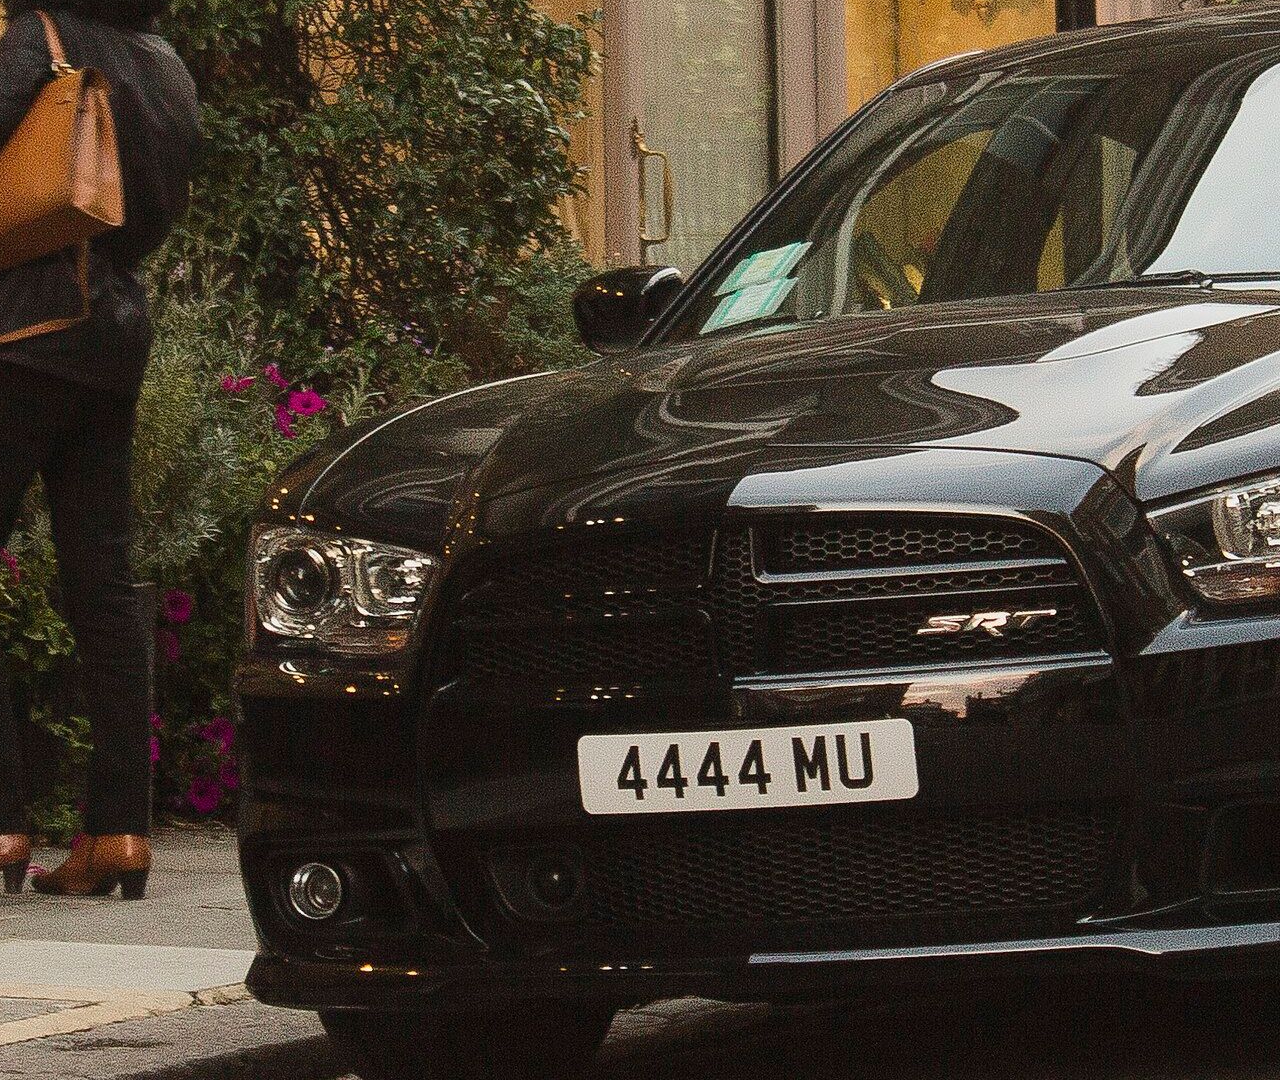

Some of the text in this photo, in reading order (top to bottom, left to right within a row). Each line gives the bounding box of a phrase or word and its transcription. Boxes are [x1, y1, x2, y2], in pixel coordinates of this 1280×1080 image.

[916, 608, 1057, 637] SRT
[617, 732, 874, 801] 4444 MU
